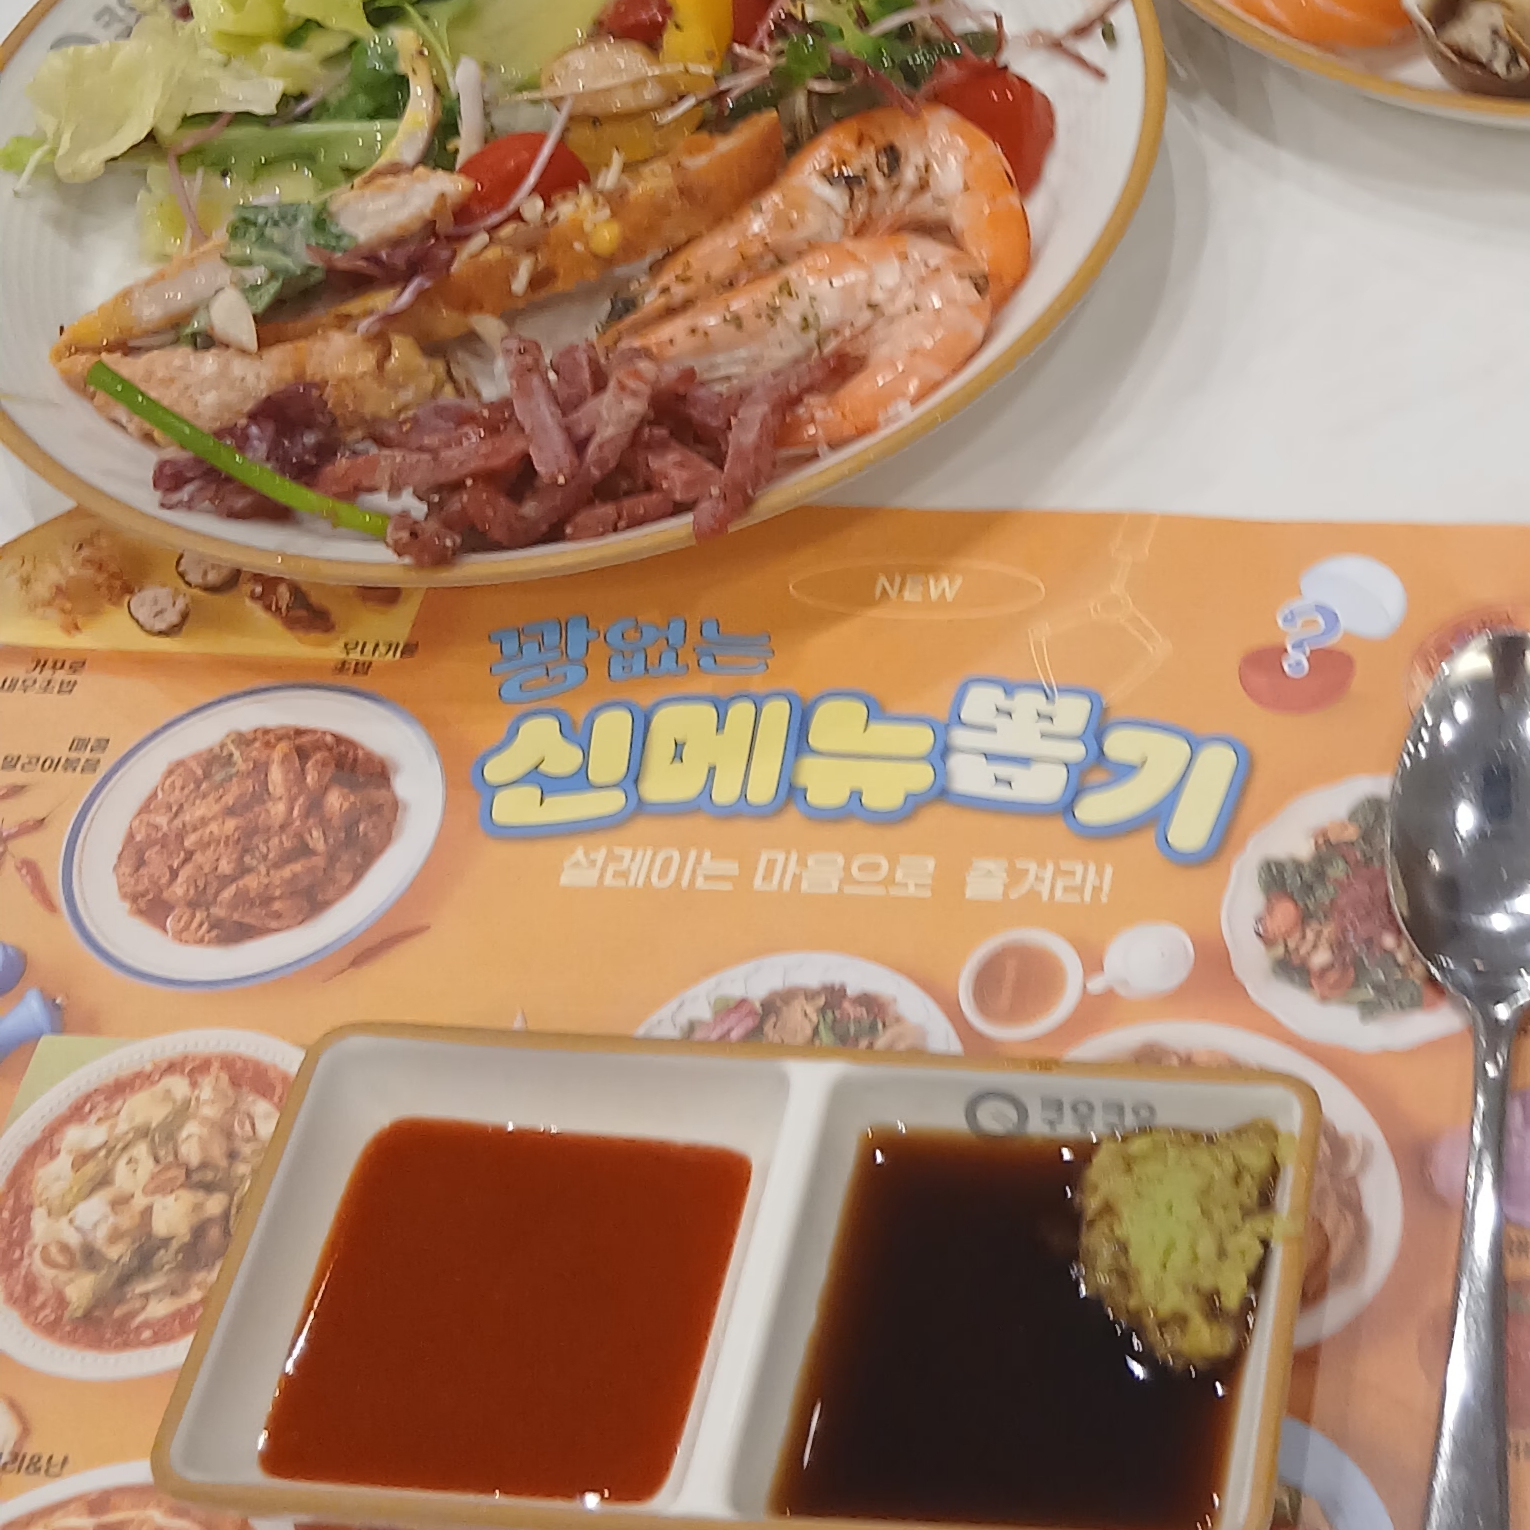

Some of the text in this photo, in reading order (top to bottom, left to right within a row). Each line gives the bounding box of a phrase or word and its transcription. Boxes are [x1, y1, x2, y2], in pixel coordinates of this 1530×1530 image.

[874, 571, 964, 603] NEW
[474, 676, 1252, 863] 신메뉴뽑기
[558, 844, 1115, 905] 설레이는 마음으로 즐겨라!
[0, 1450, 70, 1478] 리&난
